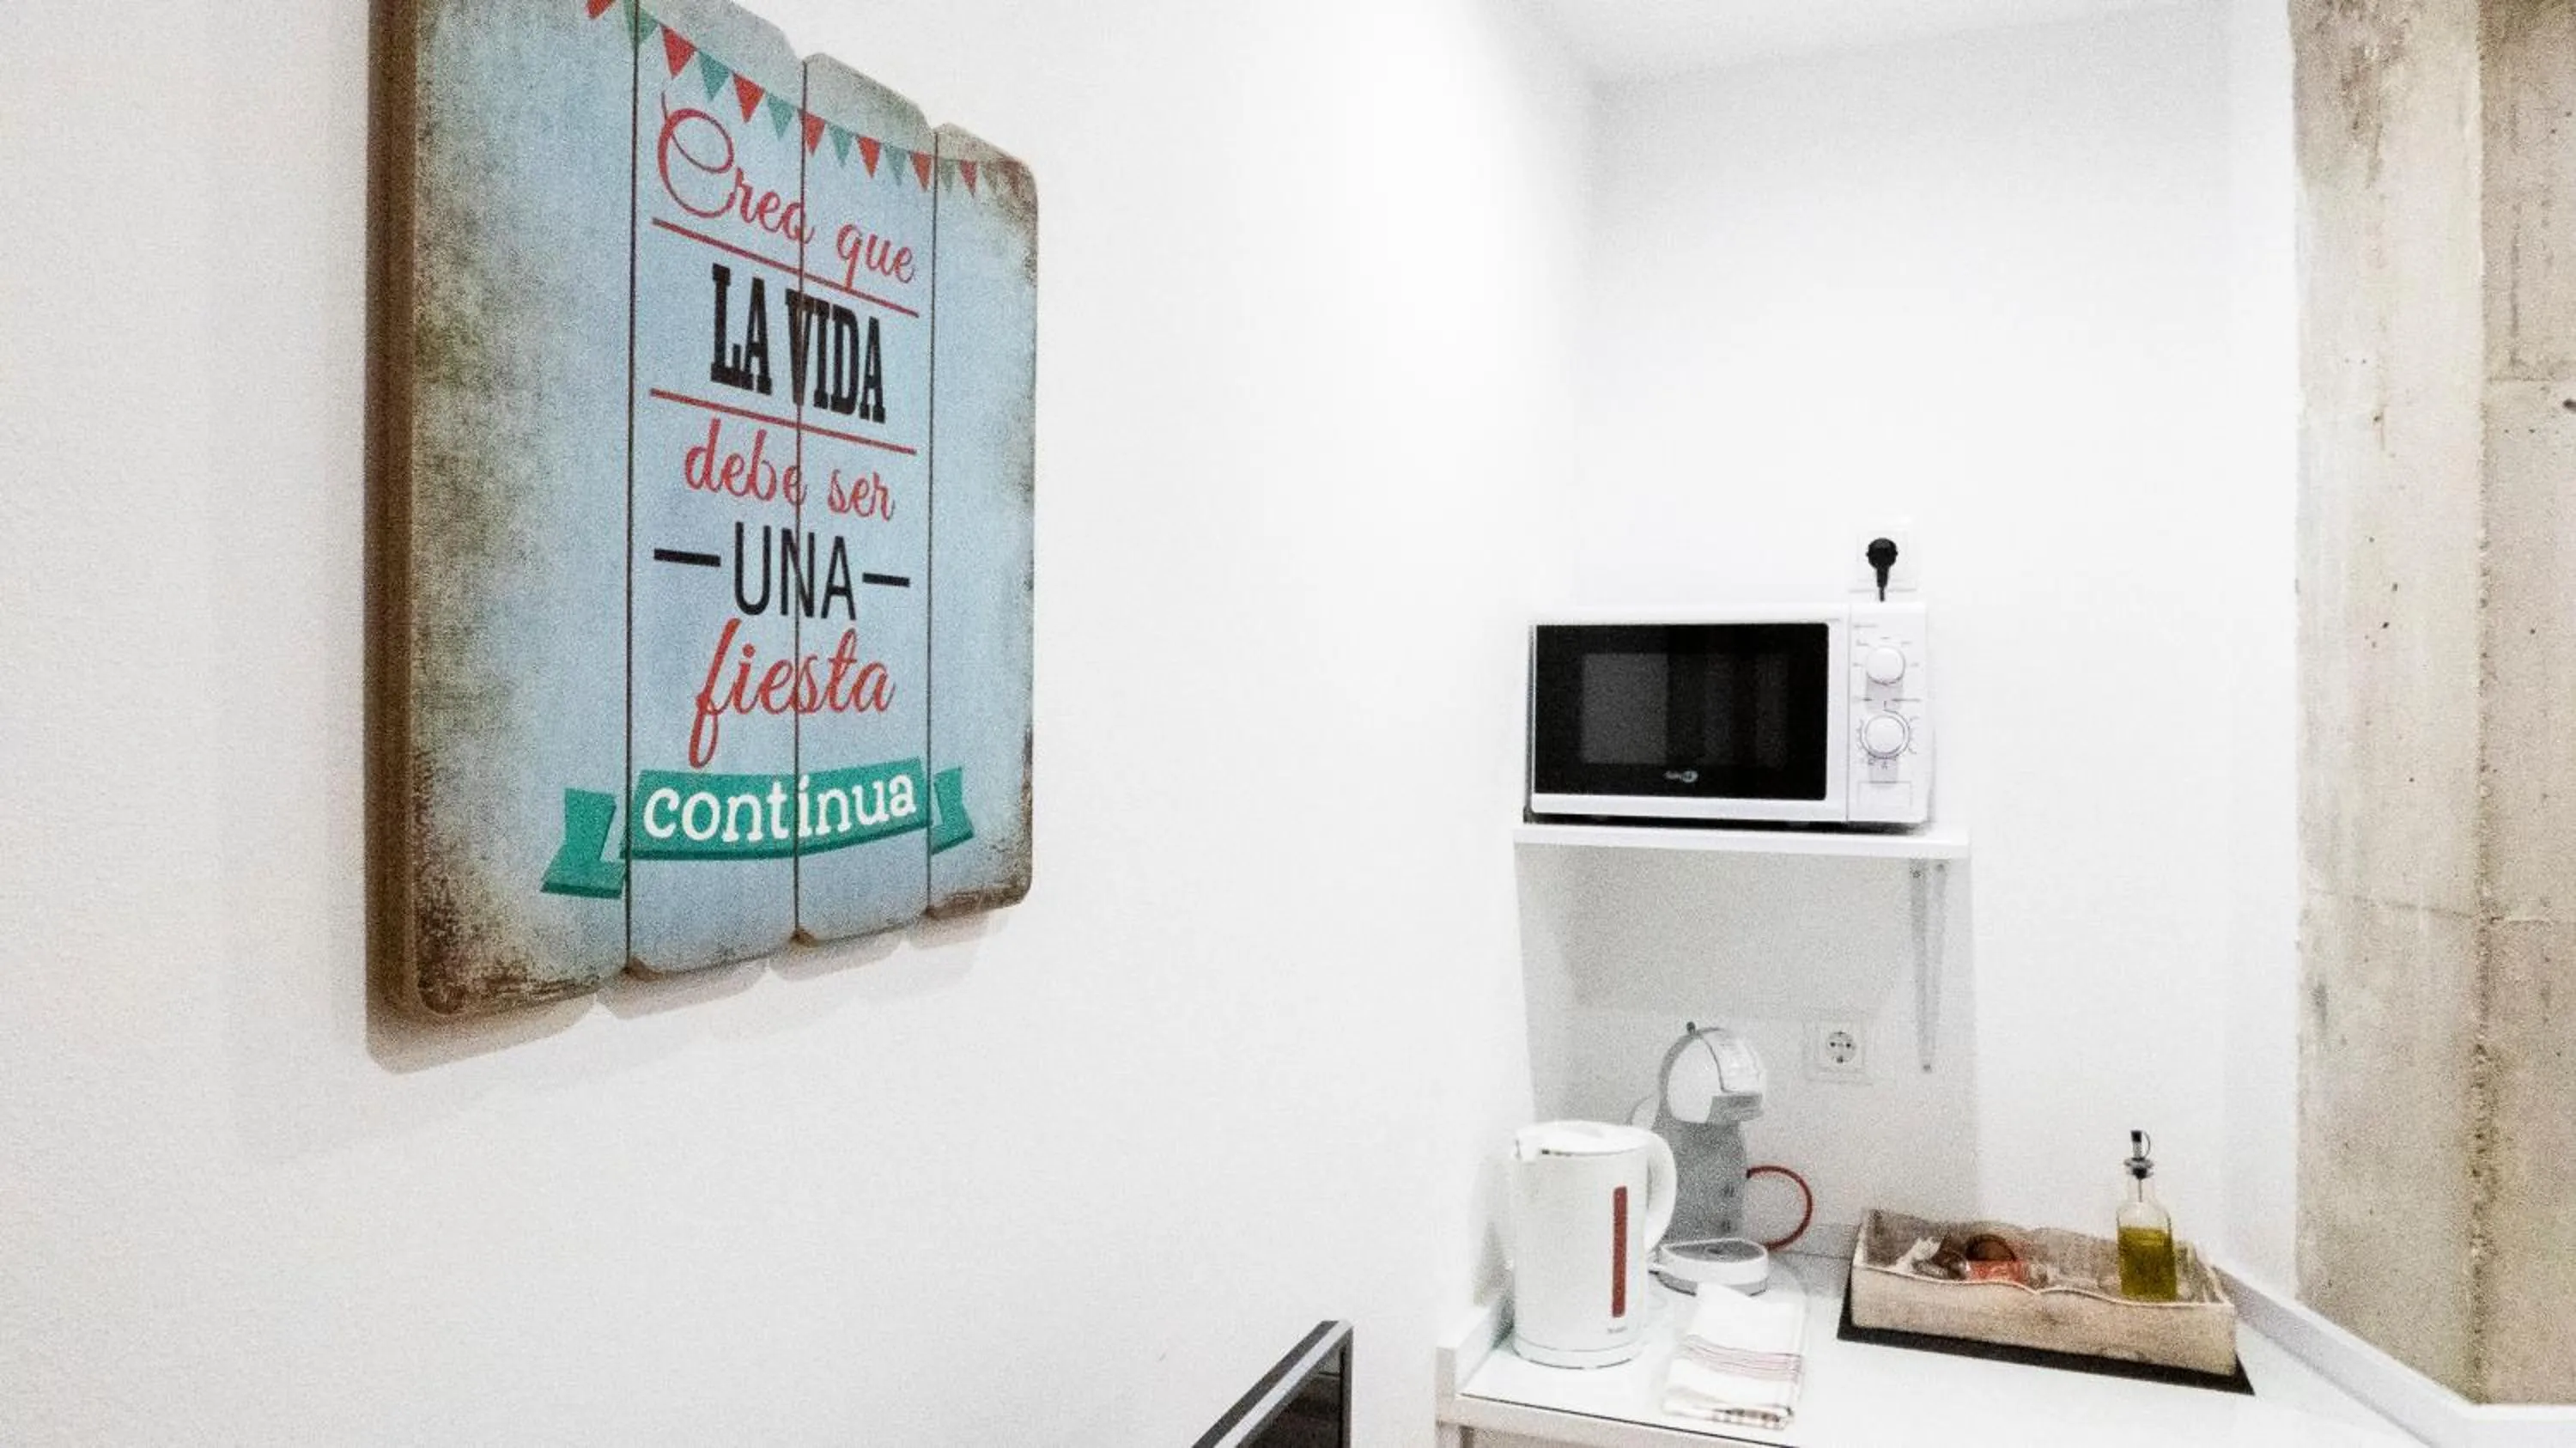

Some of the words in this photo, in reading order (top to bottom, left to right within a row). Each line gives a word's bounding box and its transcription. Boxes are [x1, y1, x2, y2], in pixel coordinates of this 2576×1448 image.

[836, 223, 916, 290] que
[710, 263, 772, 396] LA
[785, 289, 886, 423] VIDA
[685, 418, 808, 507] debe
[827, 469, 896, 521] ser
[689, 618, 896, 769] fiesta
